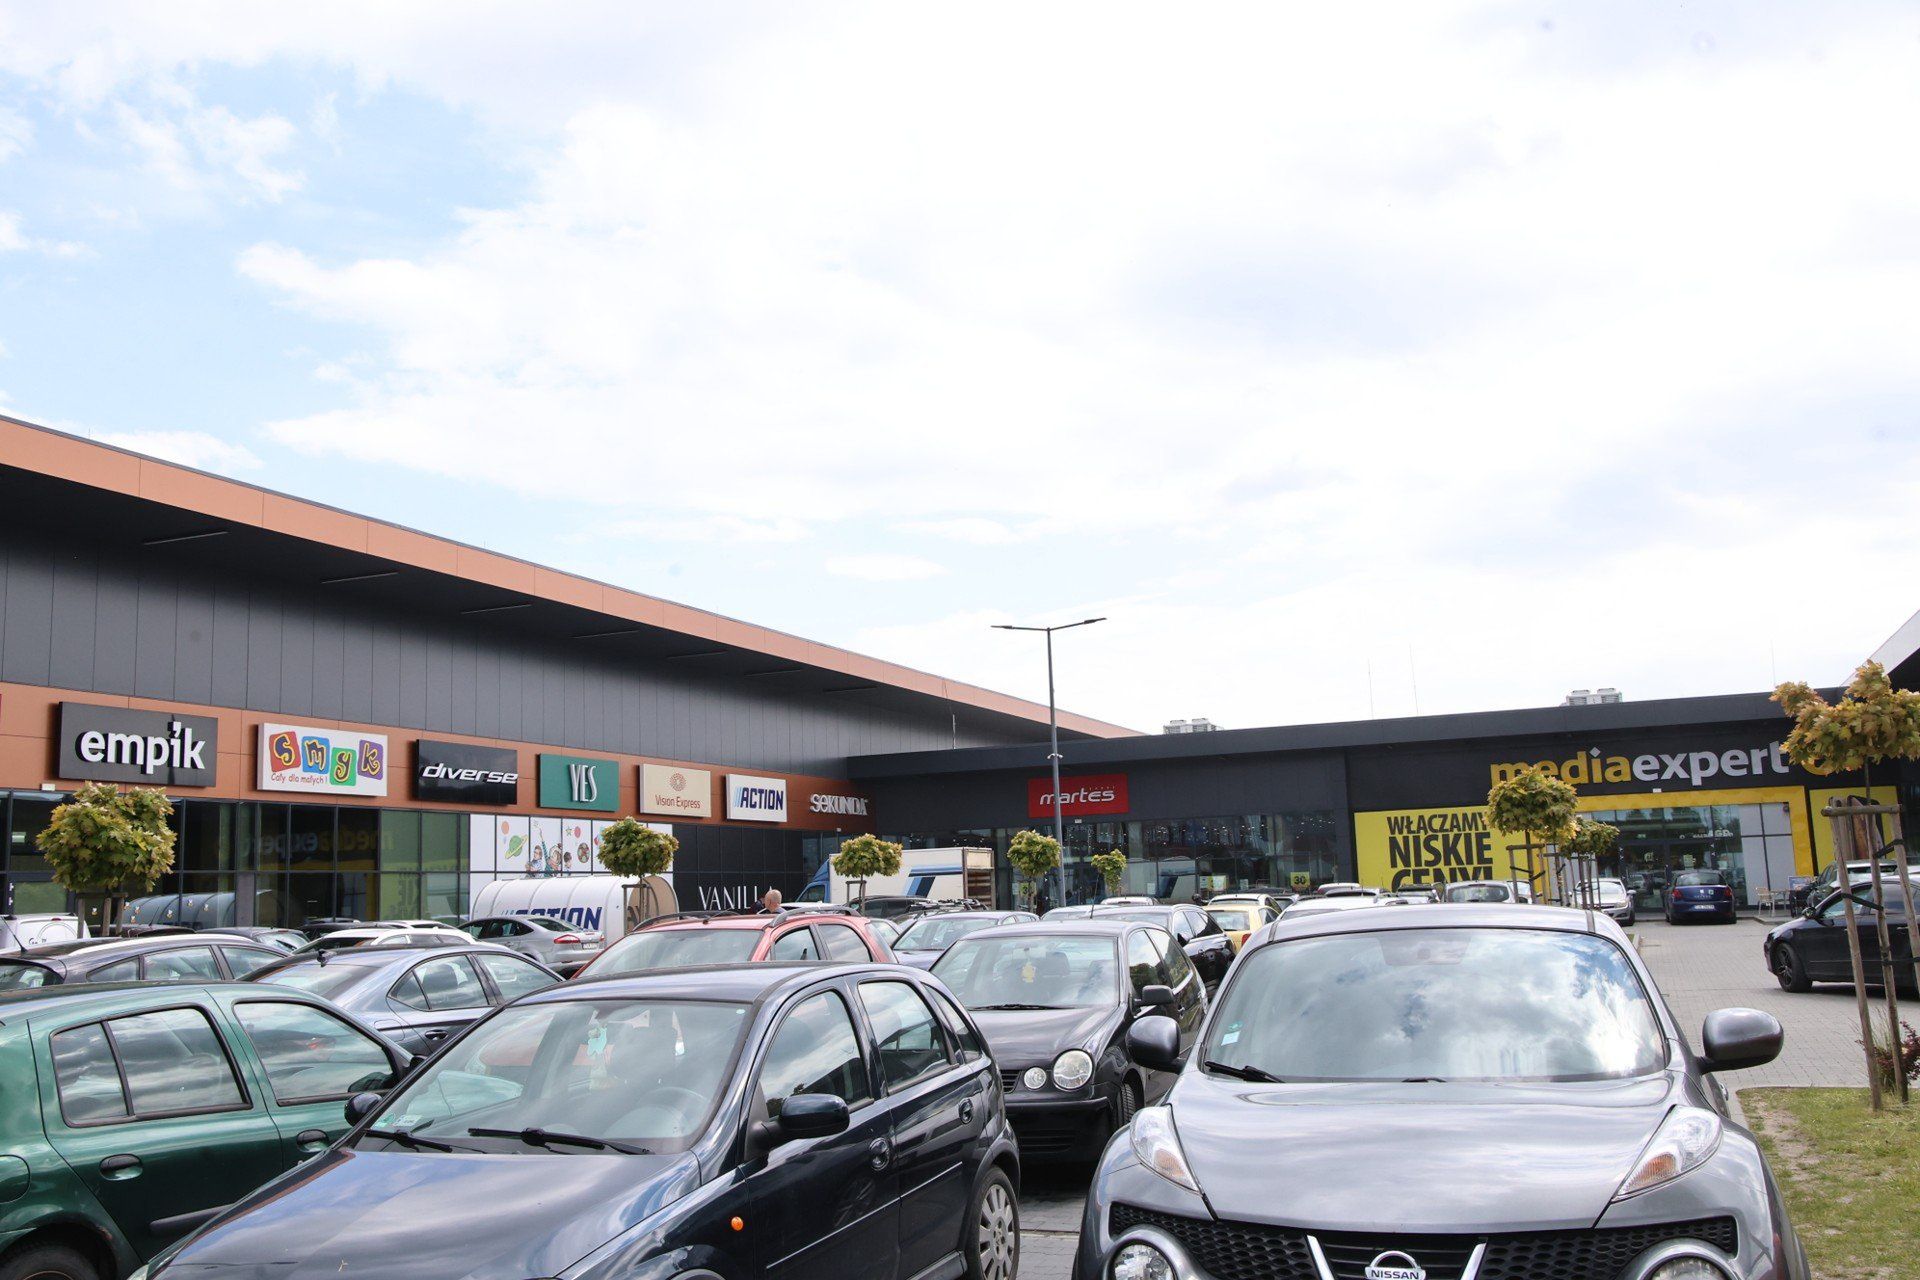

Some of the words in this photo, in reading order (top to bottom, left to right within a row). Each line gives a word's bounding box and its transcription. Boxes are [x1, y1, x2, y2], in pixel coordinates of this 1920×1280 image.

[79, 721, 206, 775] empik
[422, 763, 518, 784] diverse
[1490, 741, 1790, 786] mediaexpert
[570, 763, 598, 802] YES
[655, 795, 675, 807] Vision
[676, 797, 701, 810] Express
[741, 787, 784, 810] ACTION
[1040, 788, 1115, 805] martes
[1387, 811, 1488, 836] WŁĄCZAMY
[1388, 832, 1494, 868] NISKIE
[699, 886, 773, 910] VANILL
[515, 907, 602, 930] ION
[1371, 1270, 1419, 1280] NISSAN
